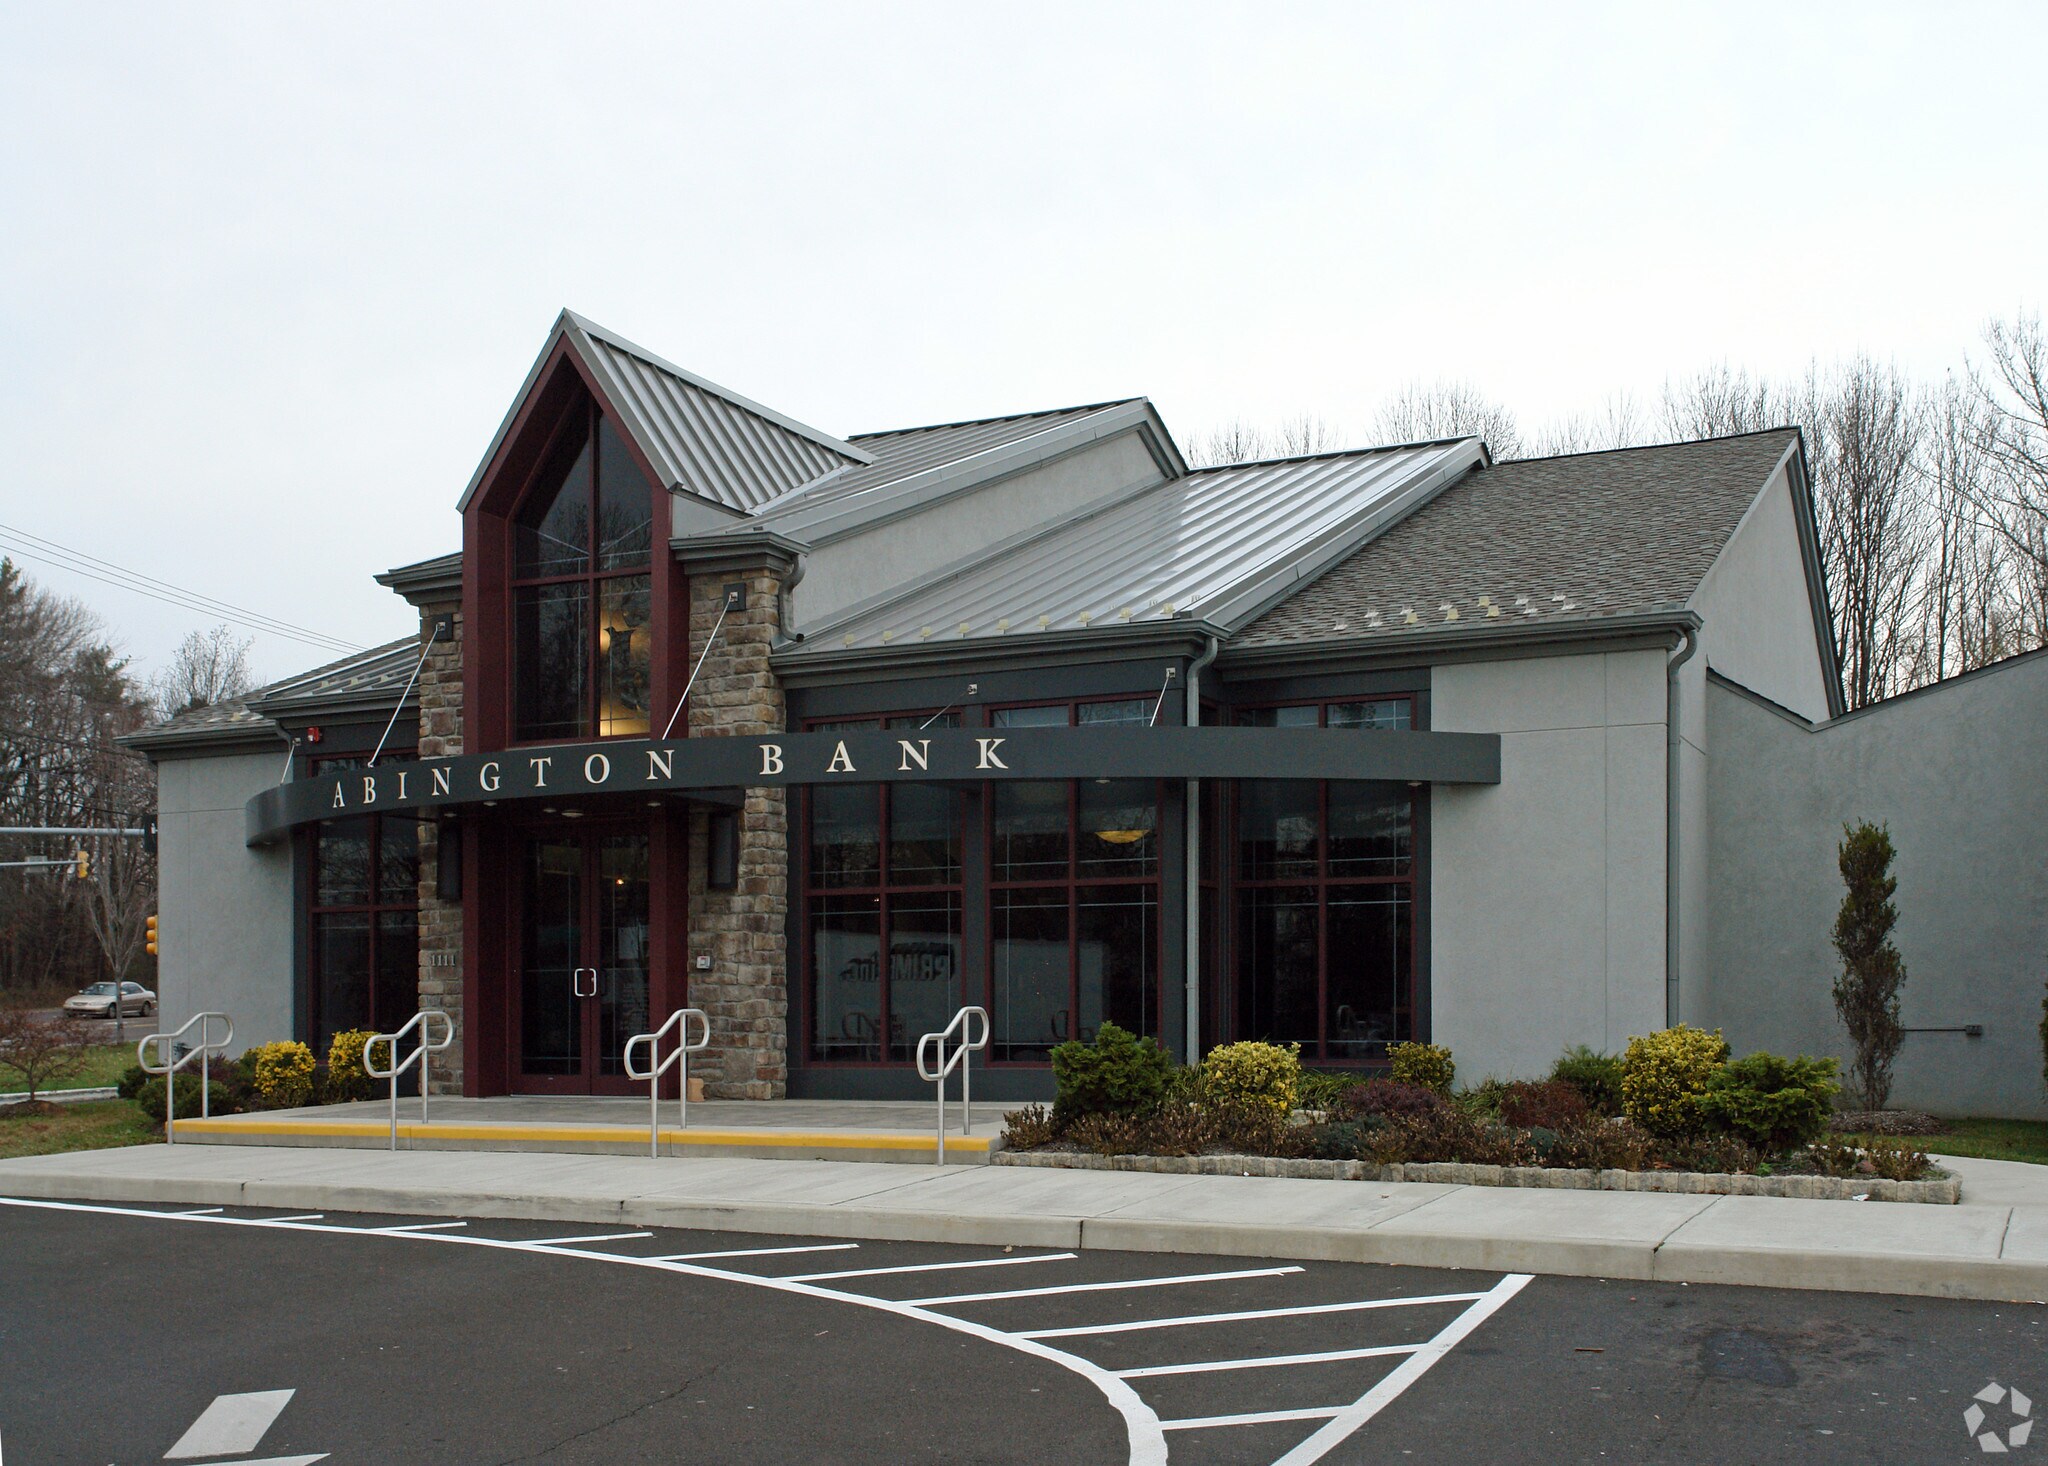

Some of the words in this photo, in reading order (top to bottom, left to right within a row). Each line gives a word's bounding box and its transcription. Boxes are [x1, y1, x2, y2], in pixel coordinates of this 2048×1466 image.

[332, 749, 675, 808] ABINGTON
[758, 738, 1009, 775] BANK
[431, 954, 456, 967] 1111
